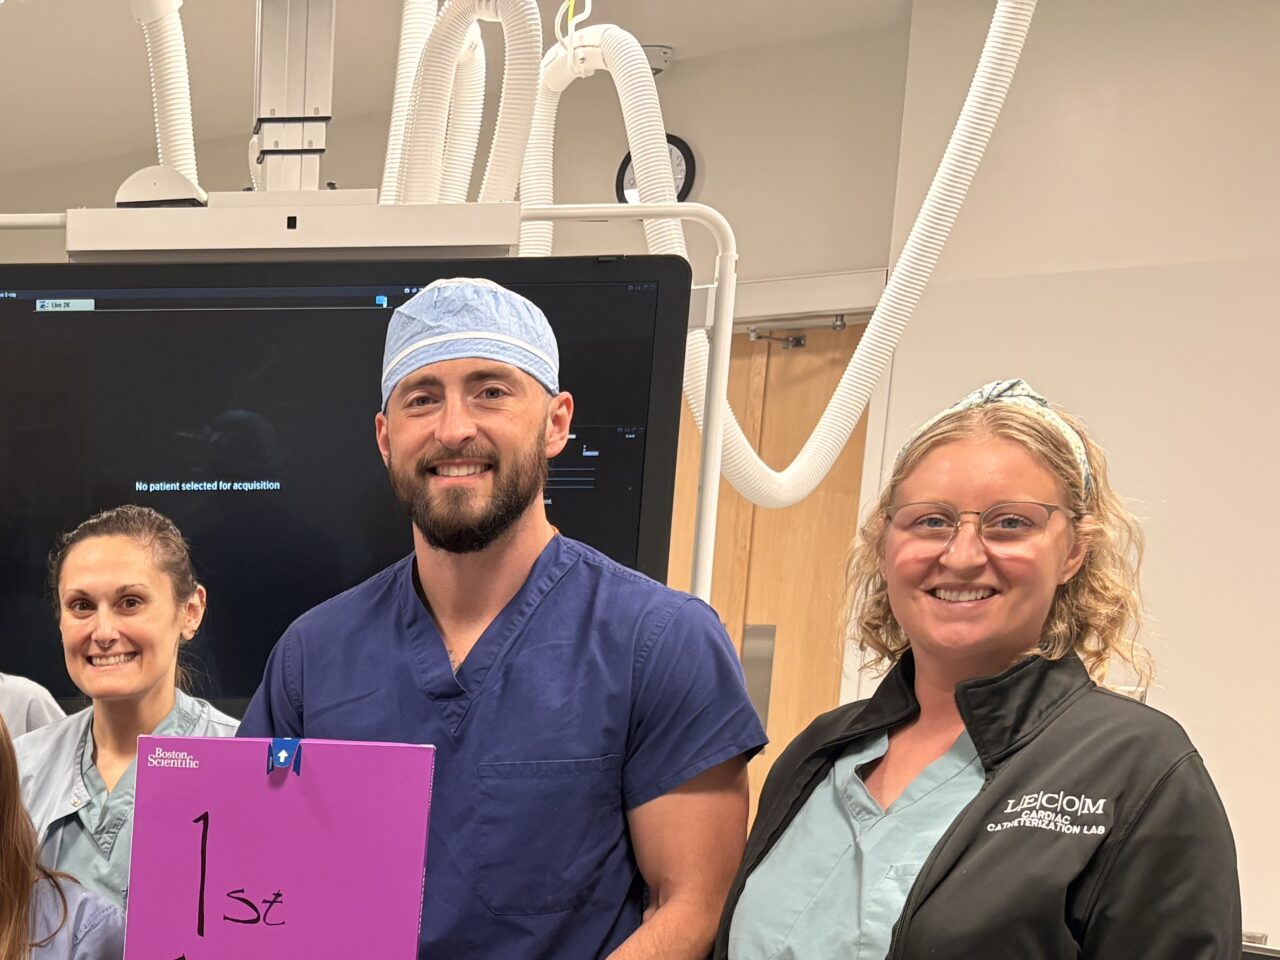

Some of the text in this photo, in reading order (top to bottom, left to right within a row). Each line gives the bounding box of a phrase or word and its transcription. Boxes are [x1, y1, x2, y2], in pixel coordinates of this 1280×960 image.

[676, 155, 683, 167] 2
[135, 480, 280, 492] No patient selected for acquisition
[155, 747, 188, 759] Boston
[147, 754, 200, 769] Scientific
[1021, 809, 1072, 825] CARDIAC
[986, 817, 1106, 835] CATHETERIZATION LAB
[192, 811, 286, 938] 1st
